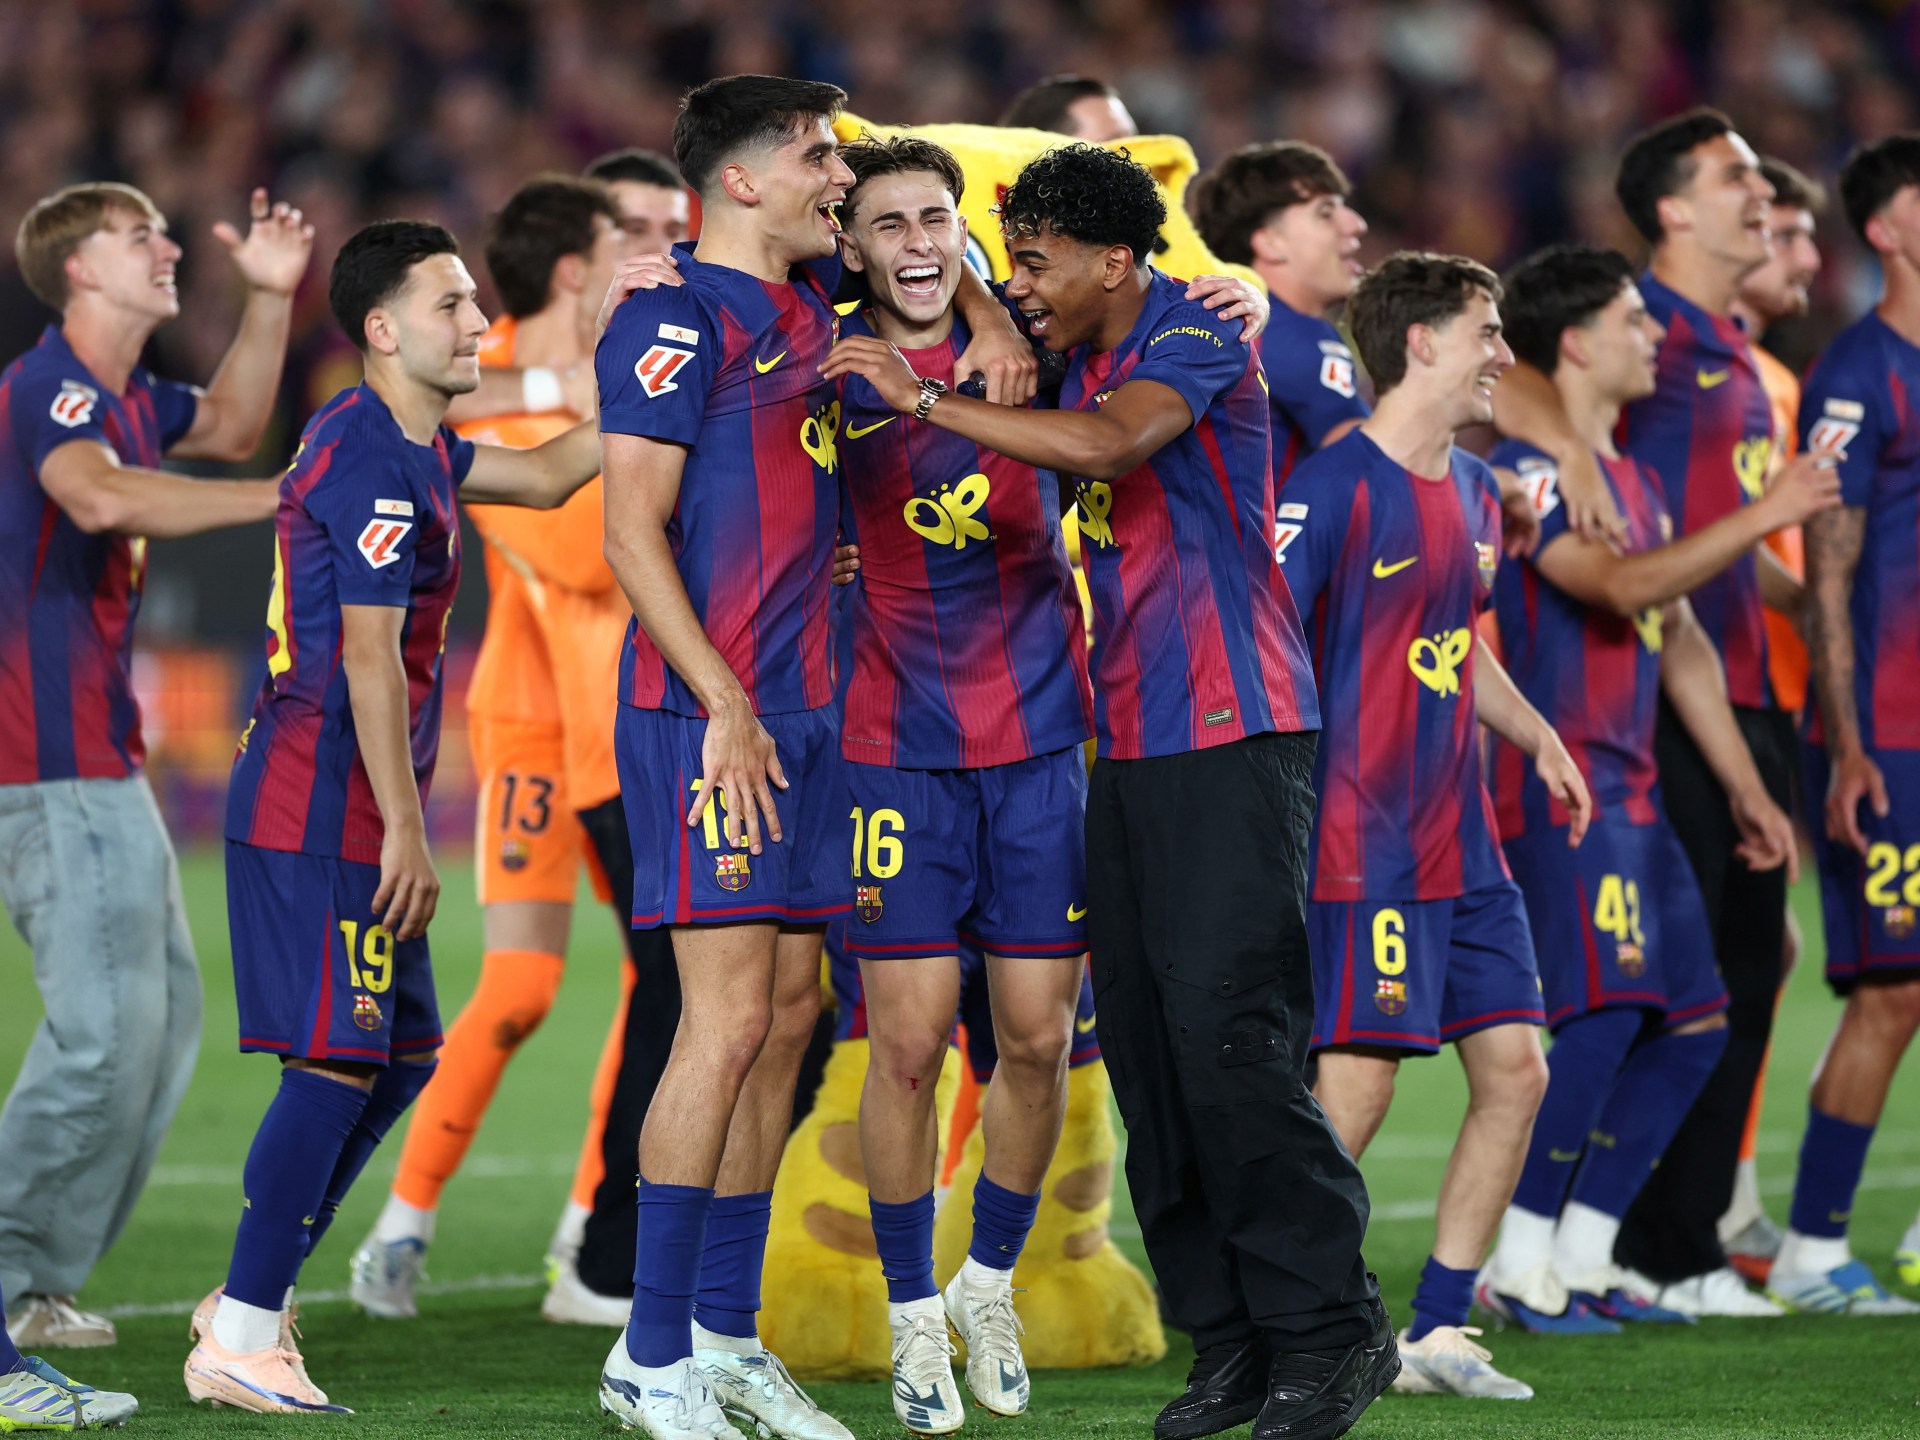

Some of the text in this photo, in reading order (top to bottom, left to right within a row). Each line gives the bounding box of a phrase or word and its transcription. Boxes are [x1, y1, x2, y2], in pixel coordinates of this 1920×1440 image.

[501, 775, 552, 833] 13
[849, 806, 905, 879] 16
[339, 920, 394, 994] 19
[1372, 907, 1407, 976] 6
